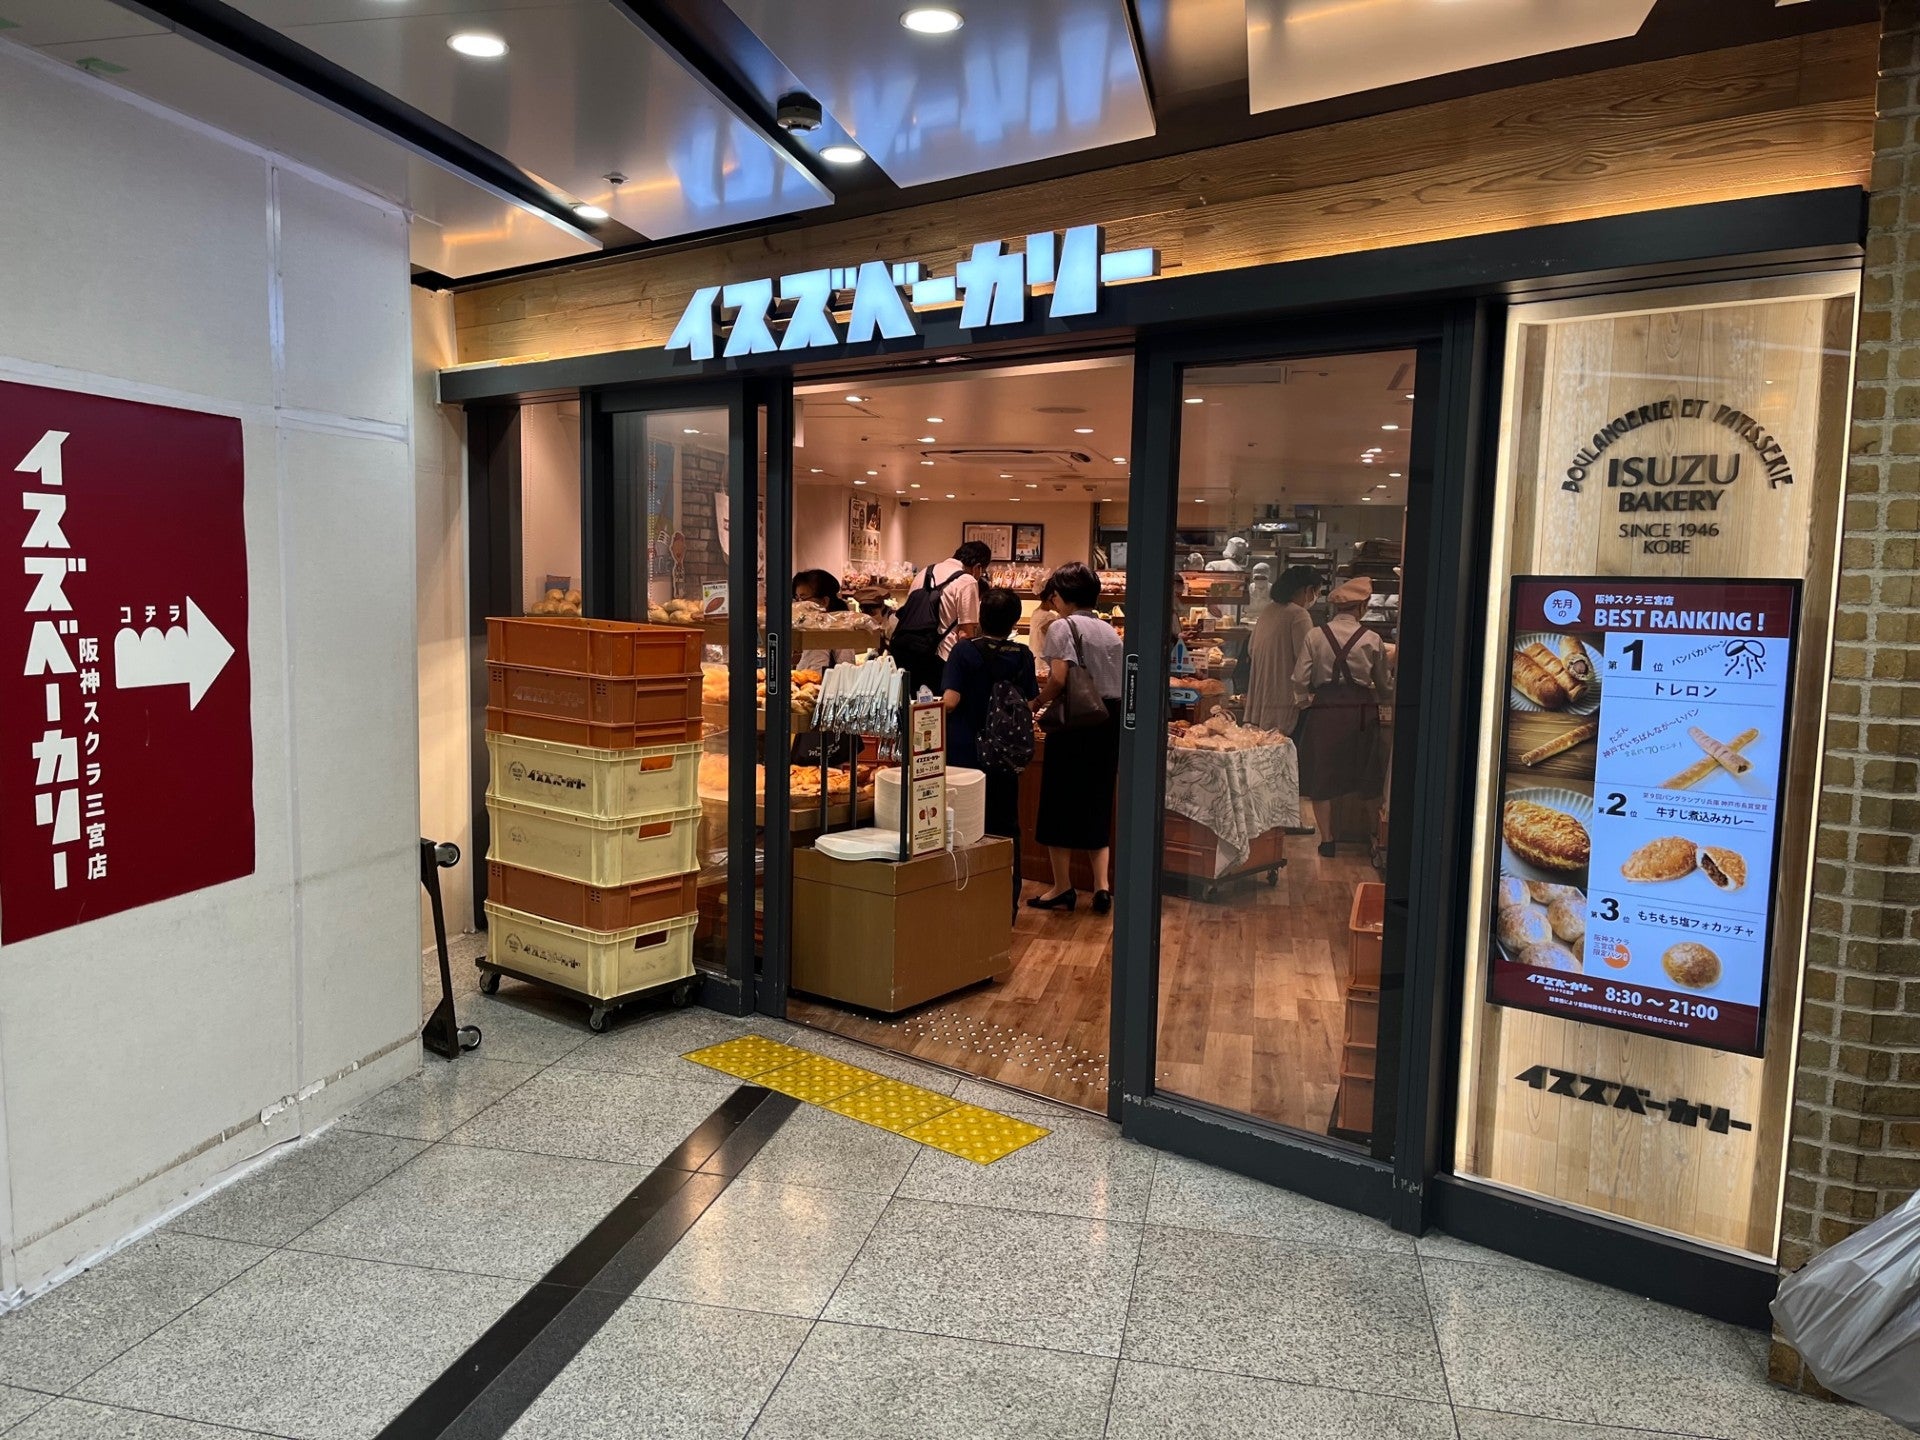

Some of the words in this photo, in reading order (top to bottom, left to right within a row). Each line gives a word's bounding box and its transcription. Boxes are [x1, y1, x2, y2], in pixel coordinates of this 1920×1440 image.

[664, 224, 1157, 361] イスズベーカリー
[1561, 400, 1674, 493] BOULANGERIE
[1681, 399, 1709, 419] ET
[1712, 404, 1794, 490] PATISSERIE
[1607, 453, 1741, 488] ISUZU
[1618, 489, 1725, 513] BAKERY
[1618, 523, 1671, 538] SINCE
[1679, 523, 1720, 537] 1946
[1643, 540, 1691, 555] KOBE
[1552, 598, 1573, 610] 先月
[1595, 594, 1675, 607] 阪神スクラ三宮店
[120, 605, 181, 623] コチラ
[1558, 609, 1567, 617] の
[1594, 608, 1645, 628] BEST
[14, 429, 87, 890] イスズベーカリー
[1655, 682, 1718, 698] トレロン
[79, 637, 108, 880] 阪神スクラ三宮店
[1656, 807, 1755, 825] 牛すじ煮込みカレー
[1637, 910, 1755, 937] もちもち塩フォカッチャ
[1605, 986, 1643, 1006] 8:30
[1668, 999, 1720, 1021] 21:00
[1514, 1064, 1752, 1135] イスズベーカリー
